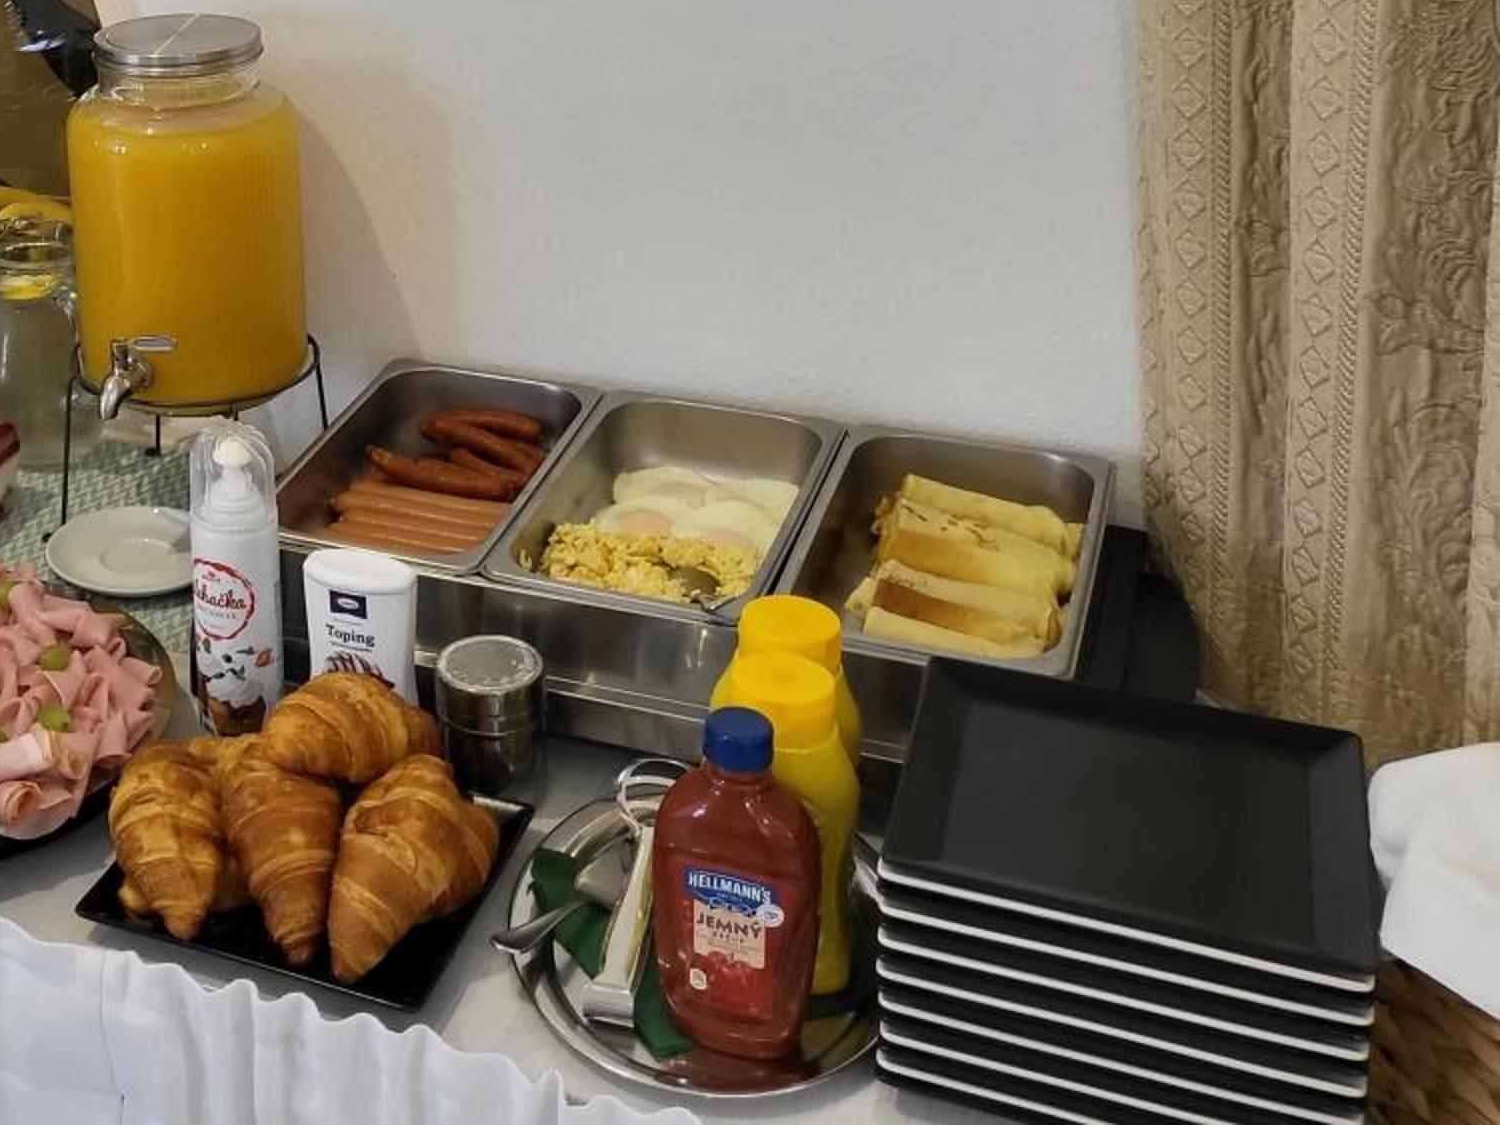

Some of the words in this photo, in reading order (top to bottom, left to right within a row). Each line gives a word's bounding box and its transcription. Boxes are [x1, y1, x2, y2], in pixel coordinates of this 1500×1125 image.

[325, 622, 376, 648] Toping
[687, 871, 772, 905] HELLMANN'S
[696, 912, 762, 940] JEMNÝ
